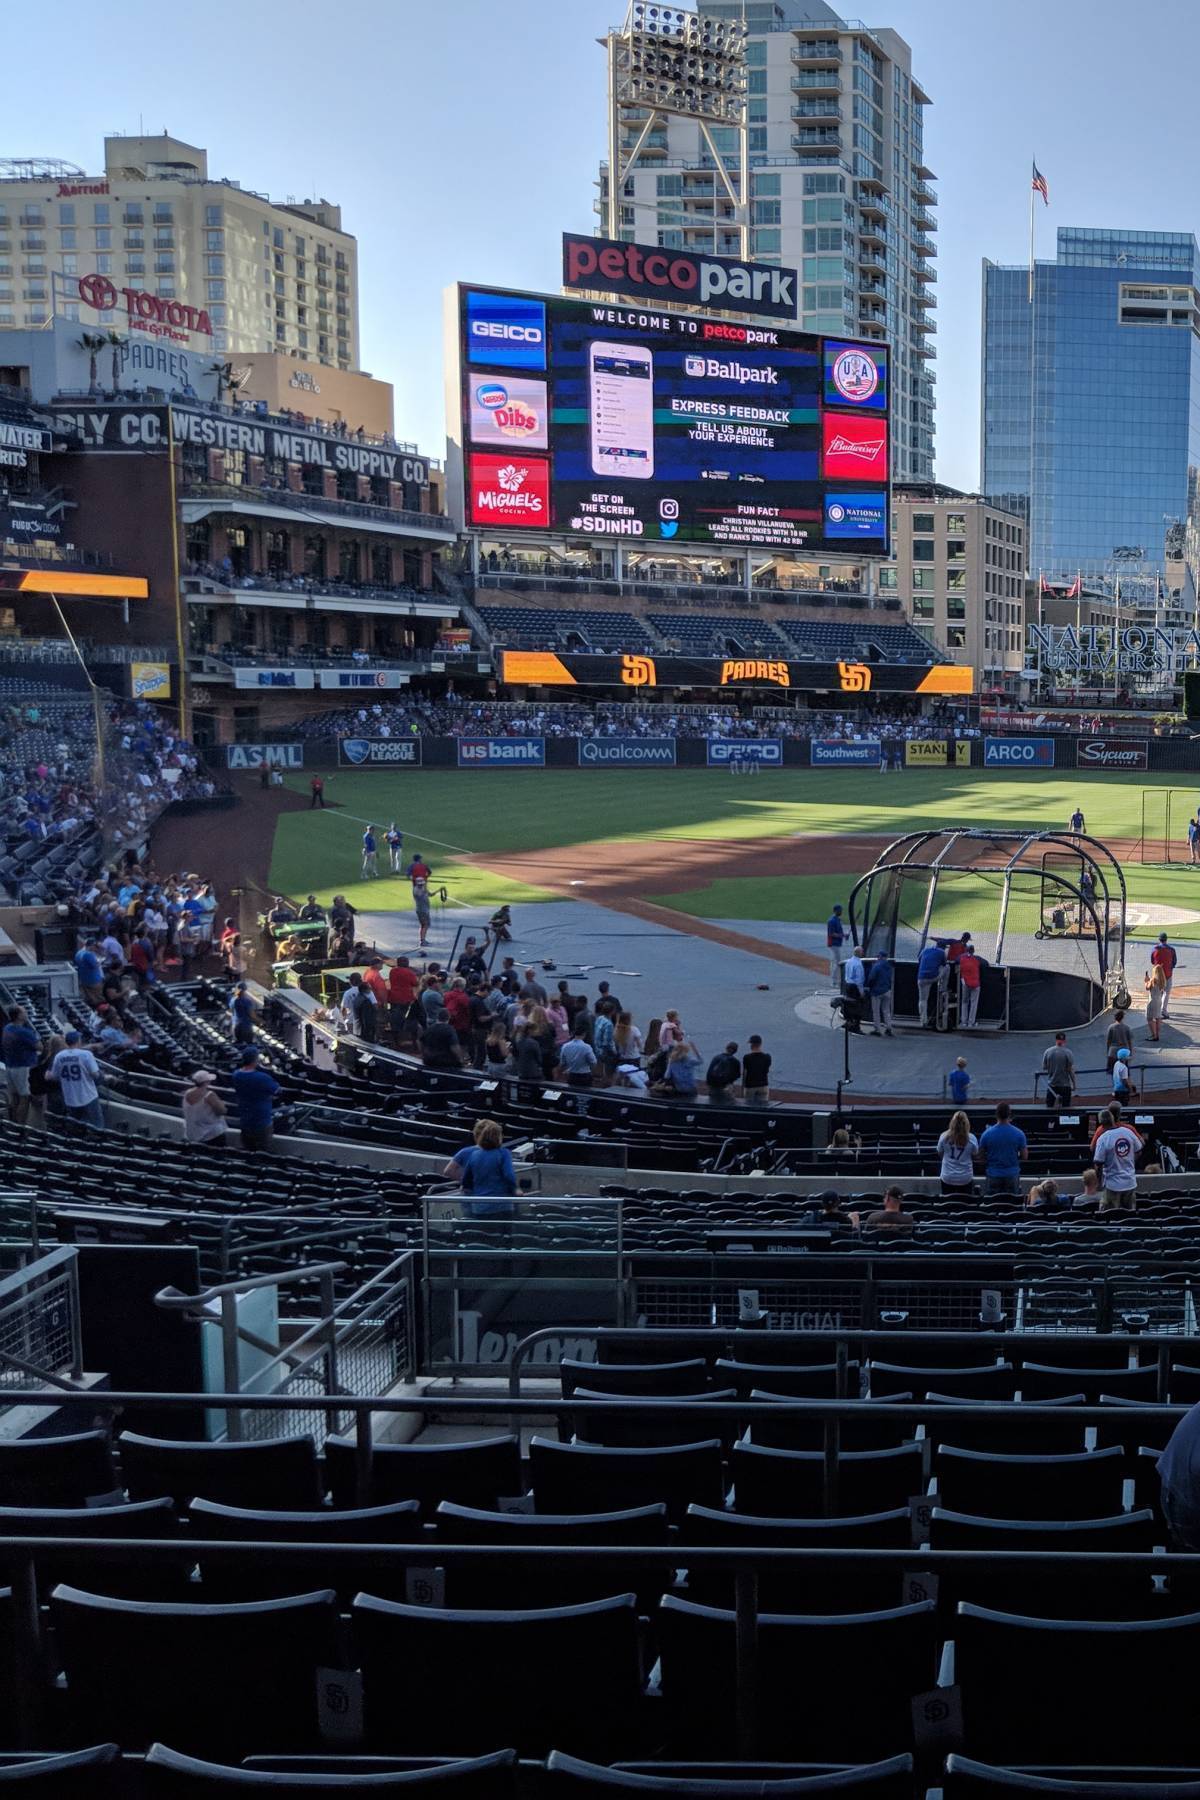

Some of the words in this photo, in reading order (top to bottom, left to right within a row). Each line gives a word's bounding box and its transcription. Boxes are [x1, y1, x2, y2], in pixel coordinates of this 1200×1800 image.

[56, 183, 110, 198] Marriott
[122, 287, 213, 336] TOYOTA
[593, 308, 671, 330] WELCOME
[679, 320, 698, 334] TO
[472, 321, 542, 343] GEICO
[120, 340, 189, 388] PADRES
[707, 359, 778, 384] Ballpark
[494, 407, 536, 430] Dibs
[672, 399, 726, 416] EXPRESS
[730, 405, 790, 423] FEEDBACK
[120, 413, 168, 445] CO.
[696, 421, 719, 432] TELL
[722, 424, 734, 434] US
[737, 426, 768, 437] ABOUT
[172, 410, 265, 454] WESTERN
[273, 432, 332, 467] METAL
[336, 445, 397, 480] SUPPLY
[403, 460, 428, 484] CO.
[689, 430, 715, 441] YOUR
[718, 433, 775, 448] EXPERIENCE
[830, 440, 879, 455] Budweiser
[592, 494, 609, 503] GET
[611, 495, 624, 504] ON
[580, 503, 598, 512] THE
[600, 505, 635, 515] SCREEN
[738, 505, 755, 514] FUN
[758, 507, 780, 516] FACT
[846, 509, 881, 518] NATIONAL
[709, 524, 730, 532] LEADS
[731, 525, 743, 533] ALL
[744, 526, 771, 535] ROOKIES
[773, 529, 789, 537] WITH
[723, 517, 756, 526] CHRISTIAN
[714, 532, 728, 540] AND
[721, 660, 790, 687] PADRES
[371, 742, 416, 752] ROCKET
[583, 742, 673, 760] Qualcomm
[816, 747, 869, 759] Southwest
[987, 745, 1035, 760] ARCO
[1080, 742, 1145, 764] Sycuan
[231, 747, 301, 768] ASML
[371, 752, 417, 761] LEAGUE
[61, 1063, 82, 1081] 49
